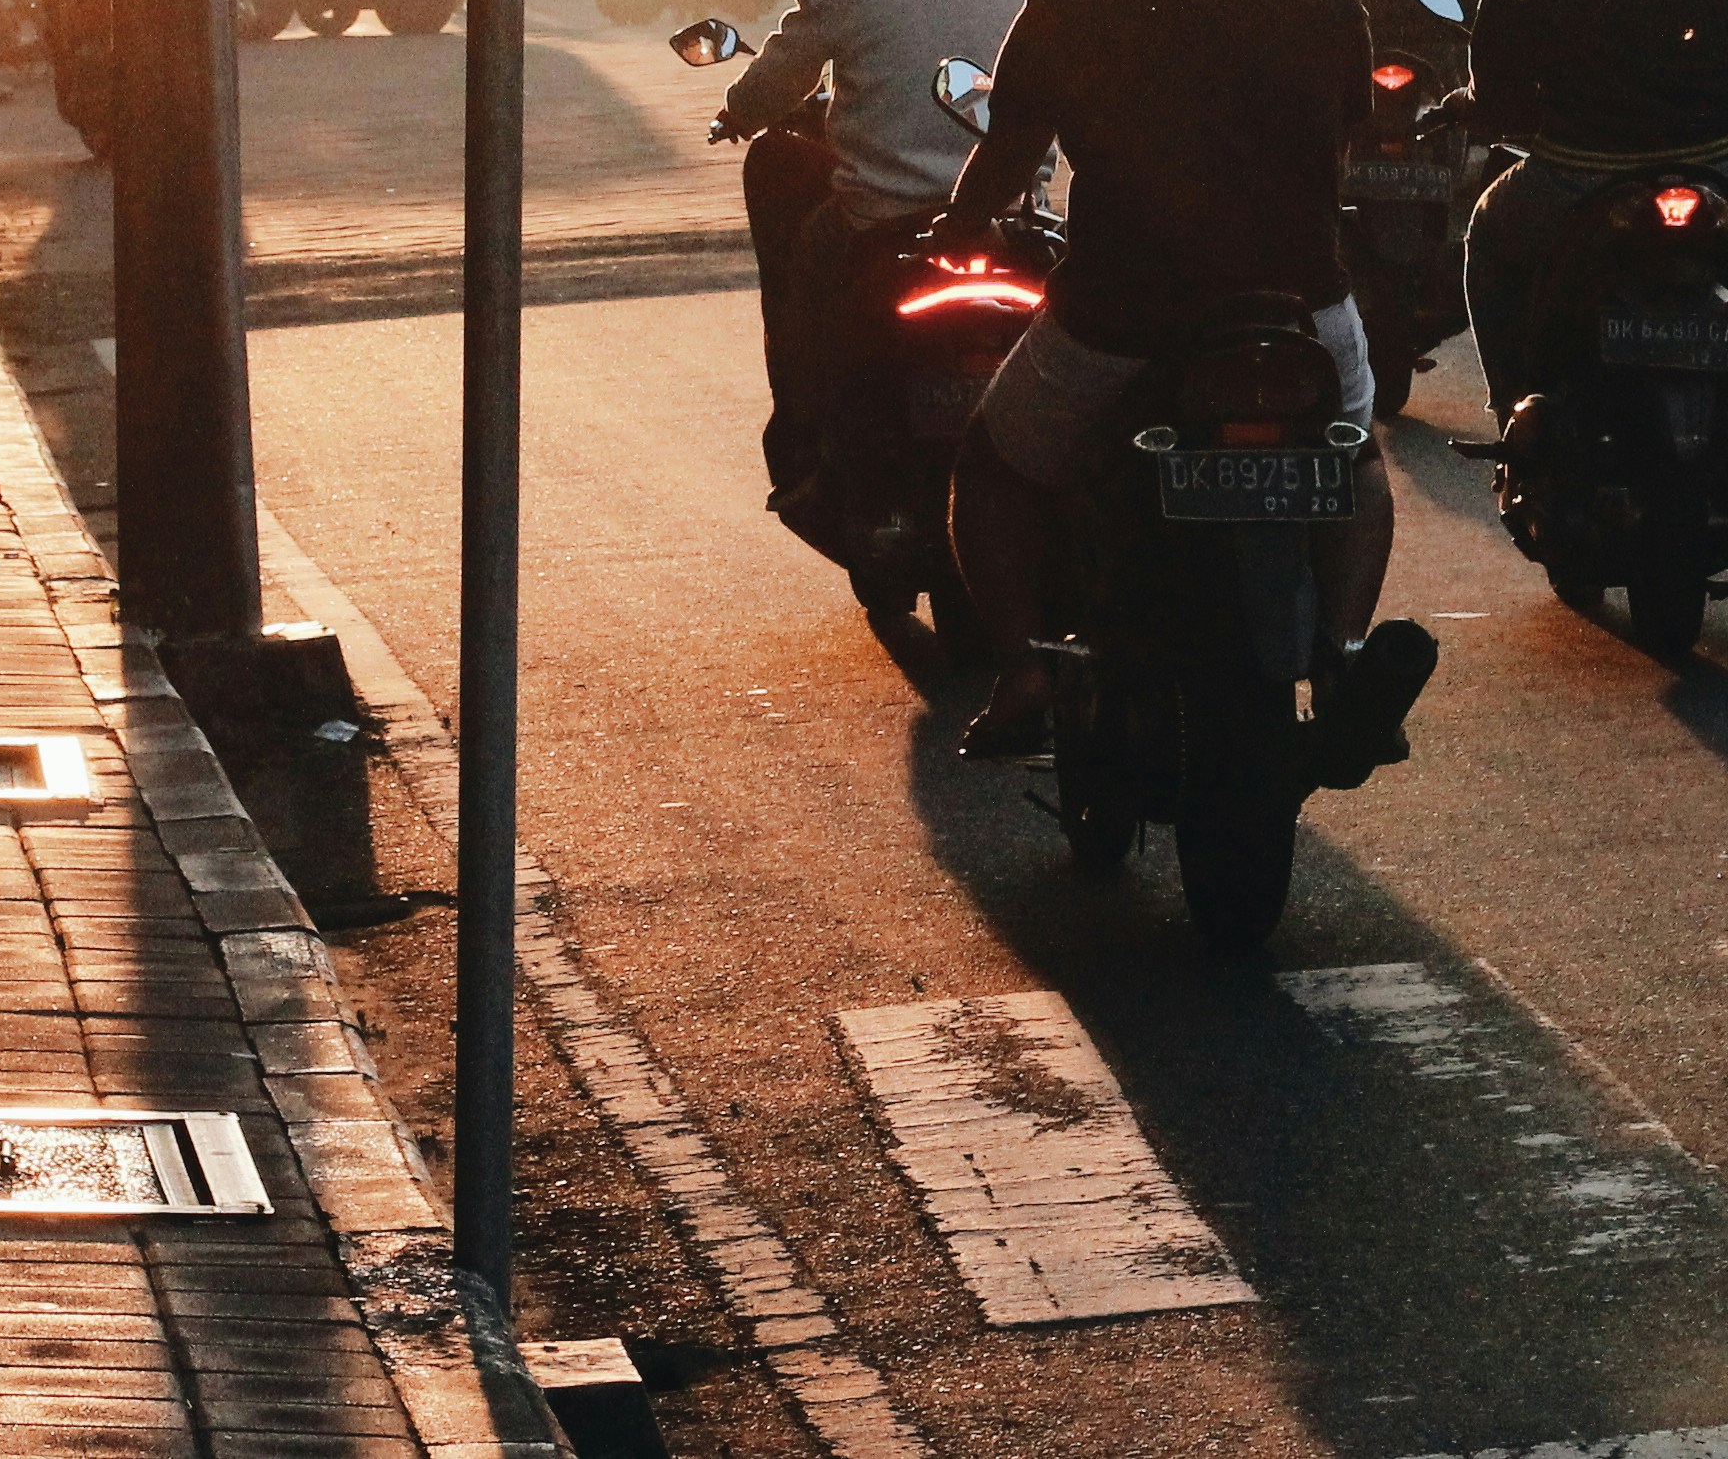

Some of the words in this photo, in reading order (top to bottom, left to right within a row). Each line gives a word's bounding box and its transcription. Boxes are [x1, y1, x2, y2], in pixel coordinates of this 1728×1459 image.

[1168, 455, 1211, 491] DK
[1217, 456, 1301, 490] 8975
[1310, 495, 1339, 513] 20
